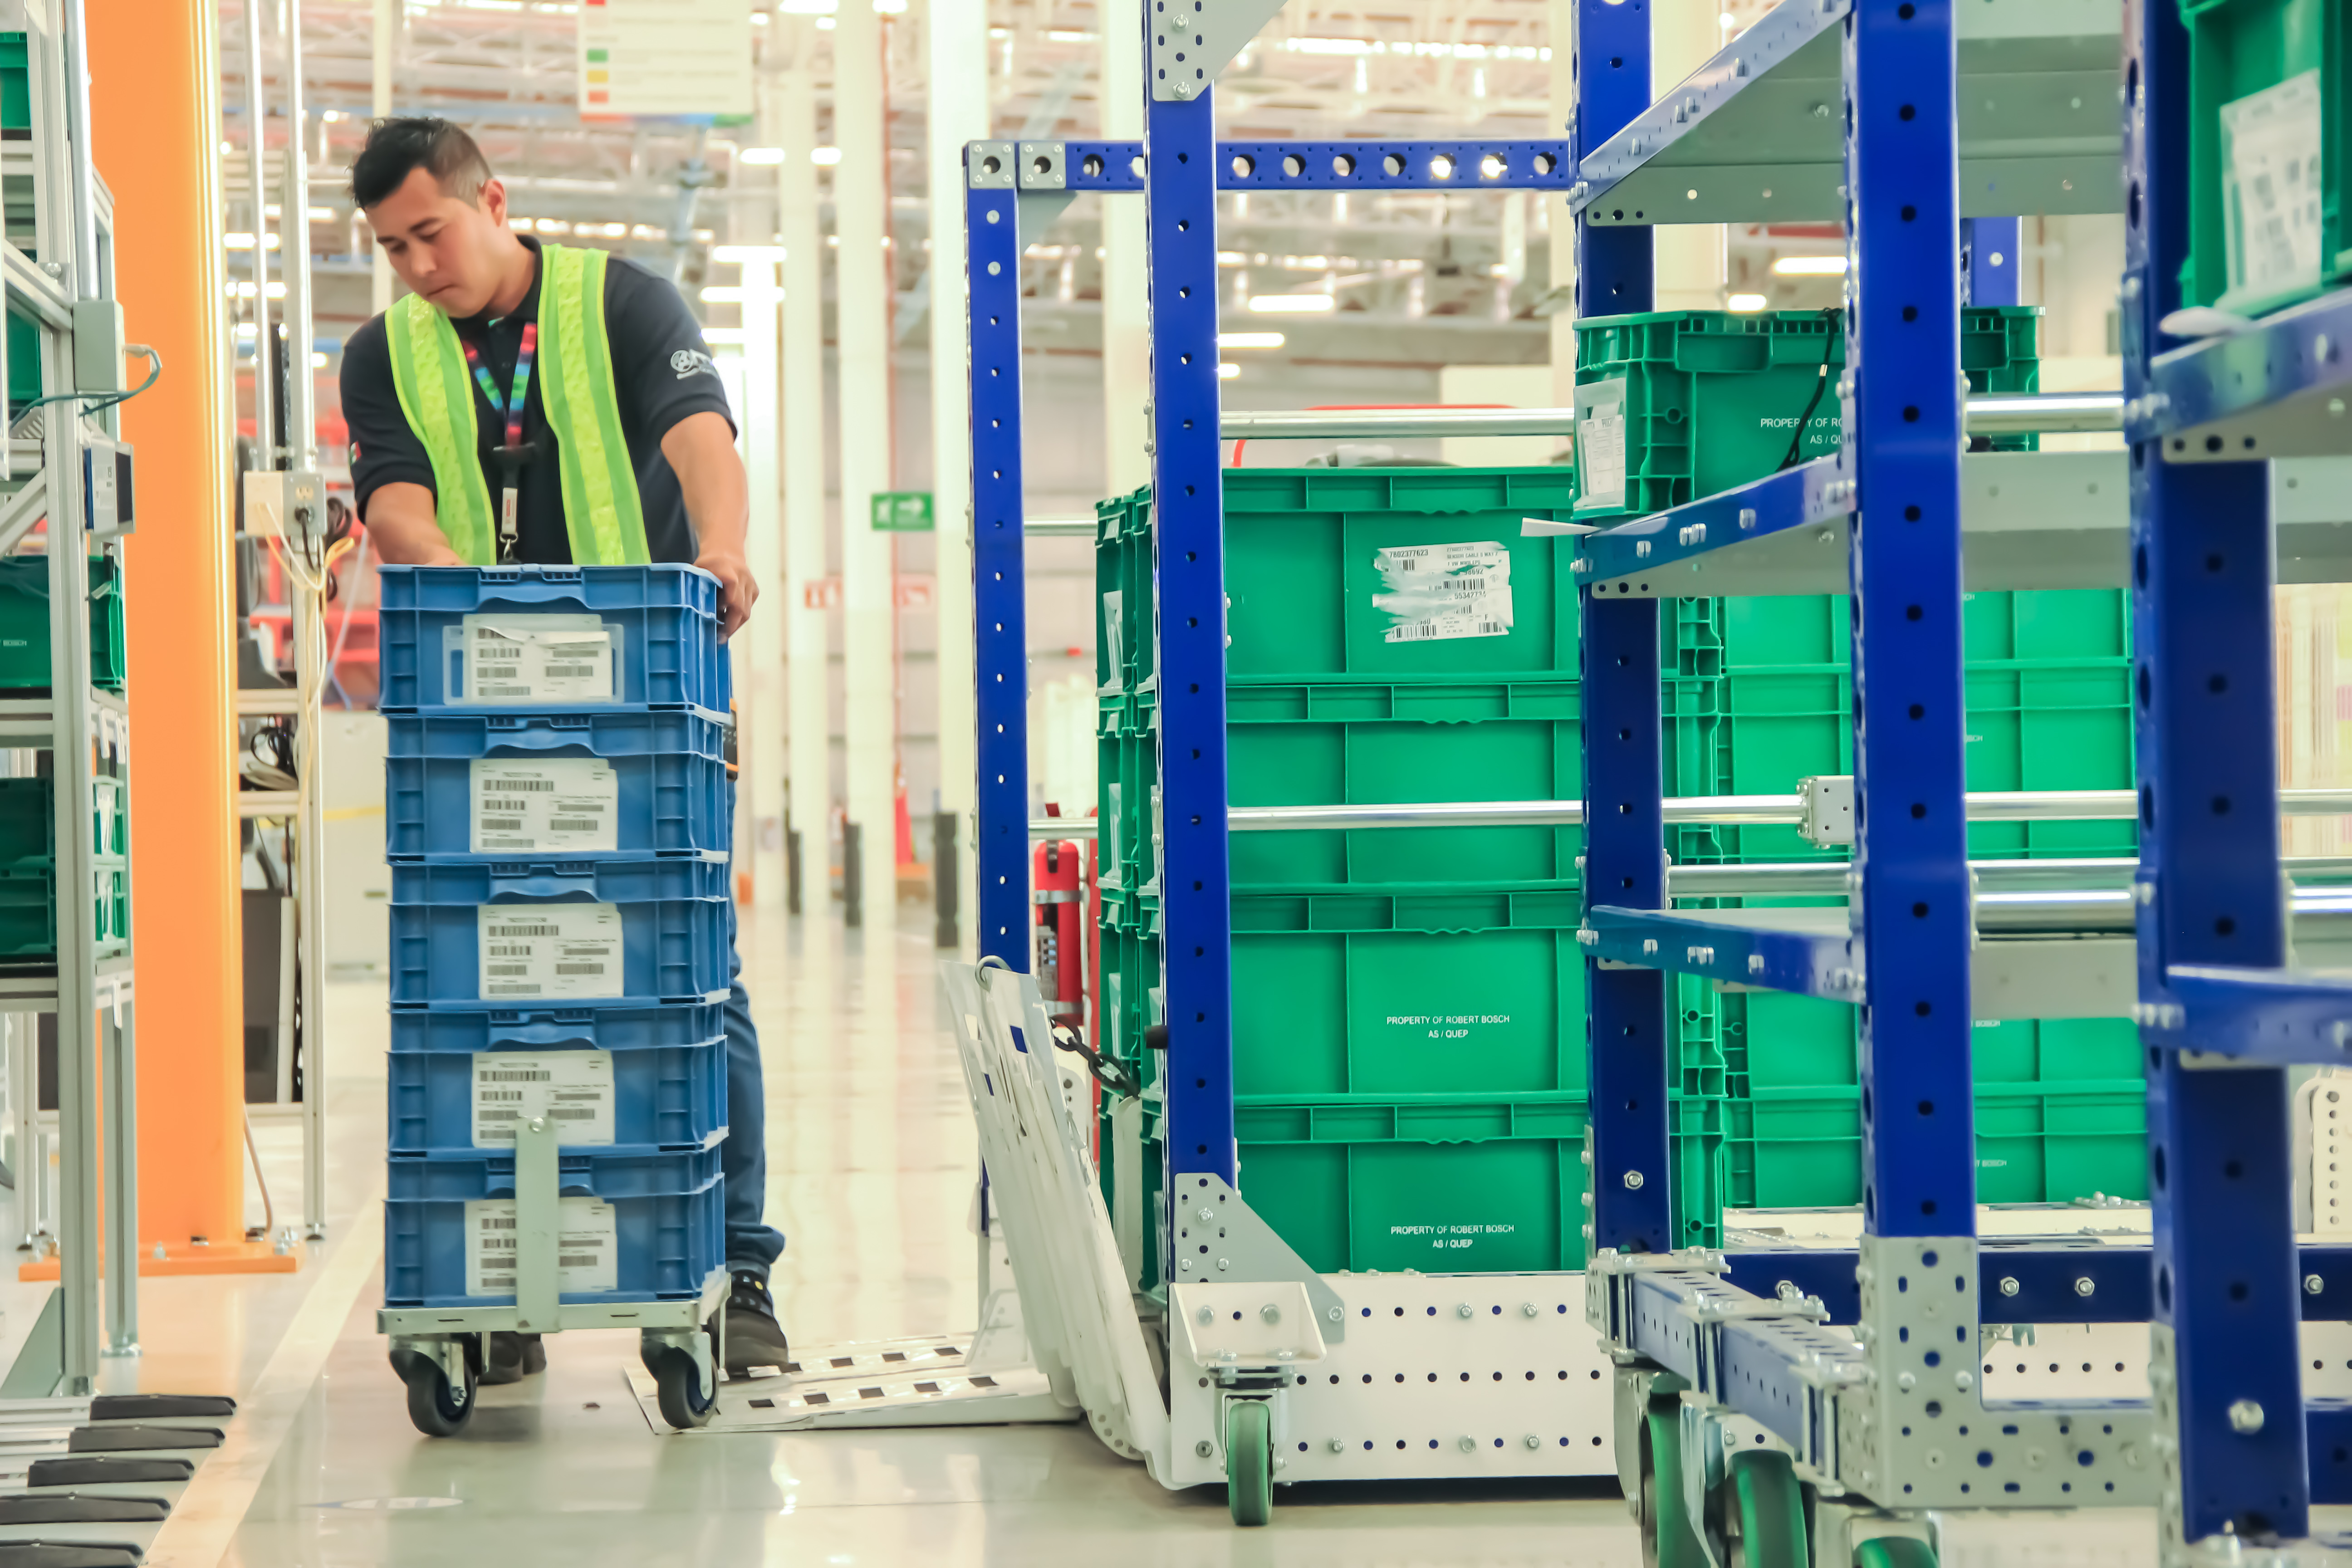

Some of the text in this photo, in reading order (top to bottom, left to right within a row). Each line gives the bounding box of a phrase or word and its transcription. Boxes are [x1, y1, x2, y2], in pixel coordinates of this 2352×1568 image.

[1760, 418, 1813, 428] PROPERY
[1815, 418, 1828, 427] OF
[1810, 435, 1823, 444] AS
[1825, 435, 1828, 444] /
[1387, 1014, 1510, 1025] PROPERTY OF ROBERT BOSCH
[1428, 1029, 1469, 1038] AS / QUEP
[1391, 1224, 1514, 1235] PROPERTY OF ROBERT BOSCH
[1432, 1239, 1473, 1248] AS / QUEP
